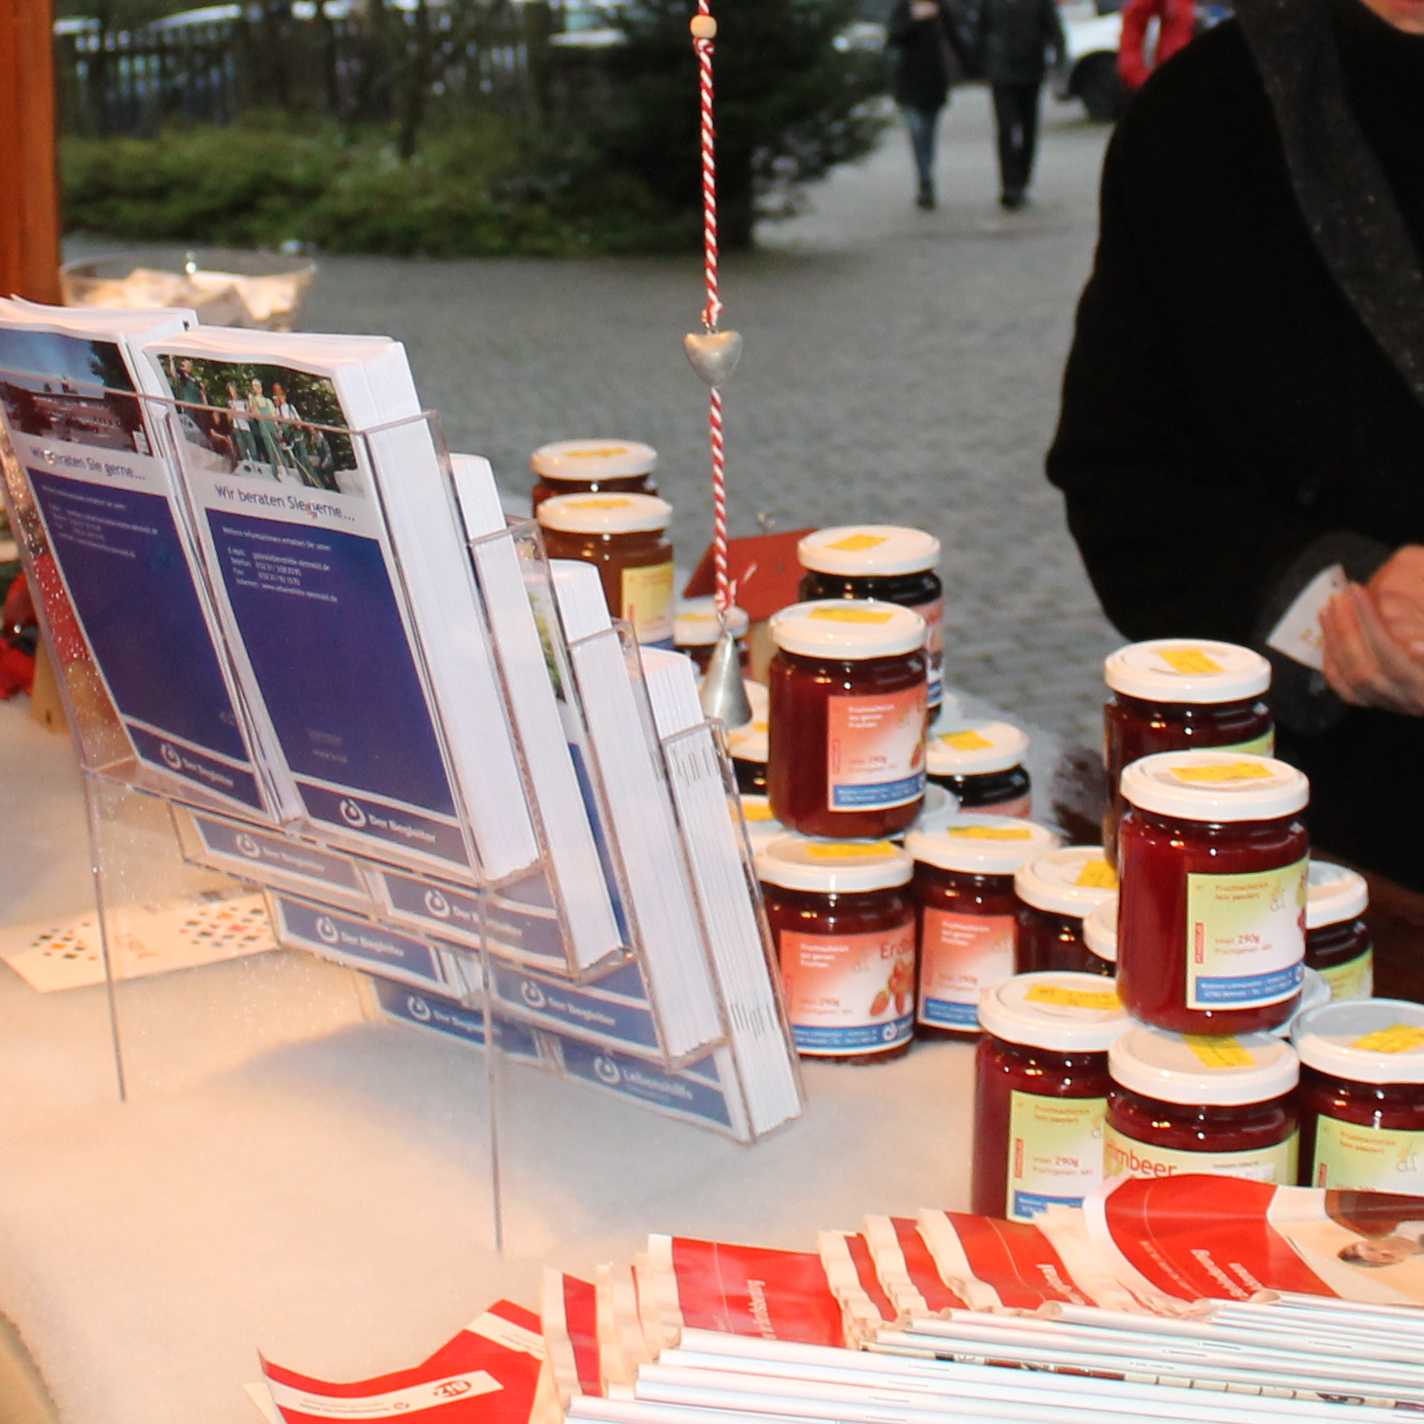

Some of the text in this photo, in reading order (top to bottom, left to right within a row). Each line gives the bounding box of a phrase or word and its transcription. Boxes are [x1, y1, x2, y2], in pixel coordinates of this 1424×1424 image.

[215, 484, 235, 498] Wir
[238, 487, 285, 509] beraten
[1238, 934, 1261, 946] 290g
